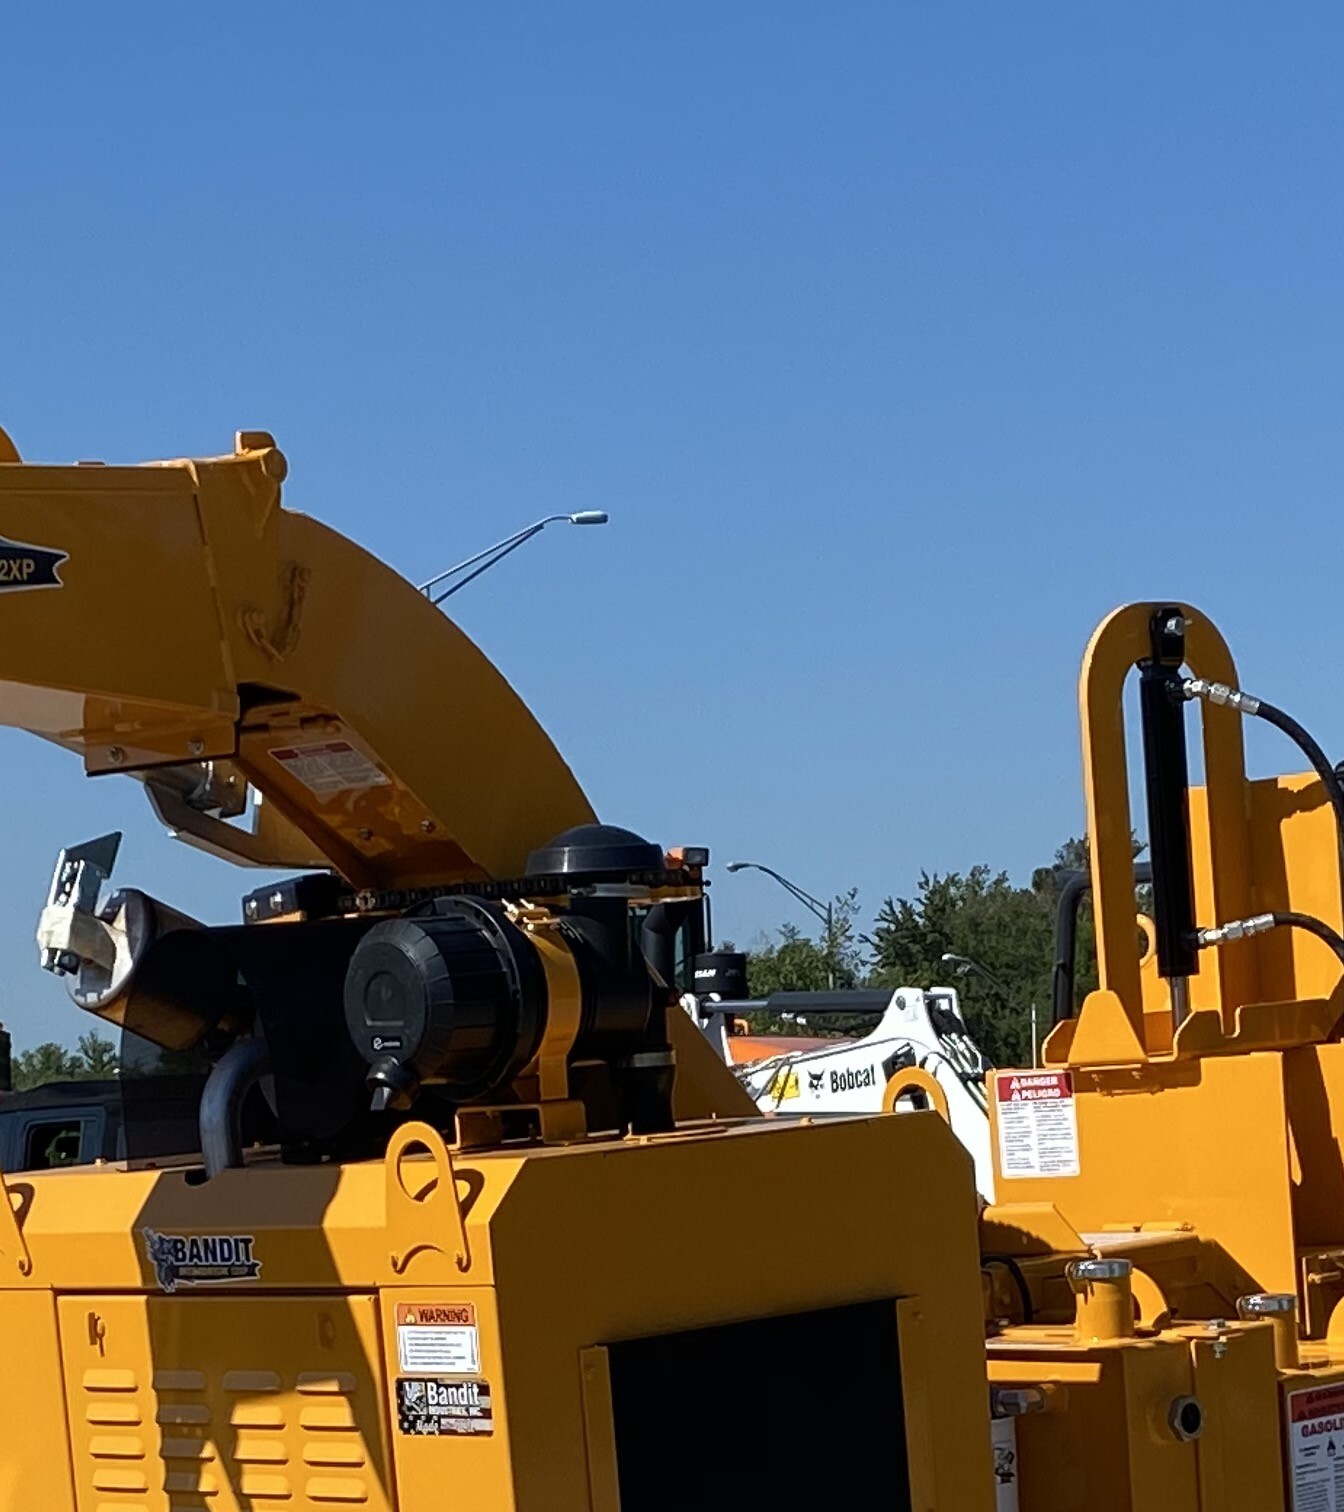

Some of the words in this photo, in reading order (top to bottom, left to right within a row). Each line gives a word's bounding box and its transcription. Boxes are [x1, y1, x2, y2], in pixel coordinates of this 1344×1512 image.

[830, 1064, 876, 1093] Bobcat
[173, 1236, 254, 1264] BANDIT
[418, 1308, 469, 1322] WARNING
[426, 1382, 480, 1405] Bandit
